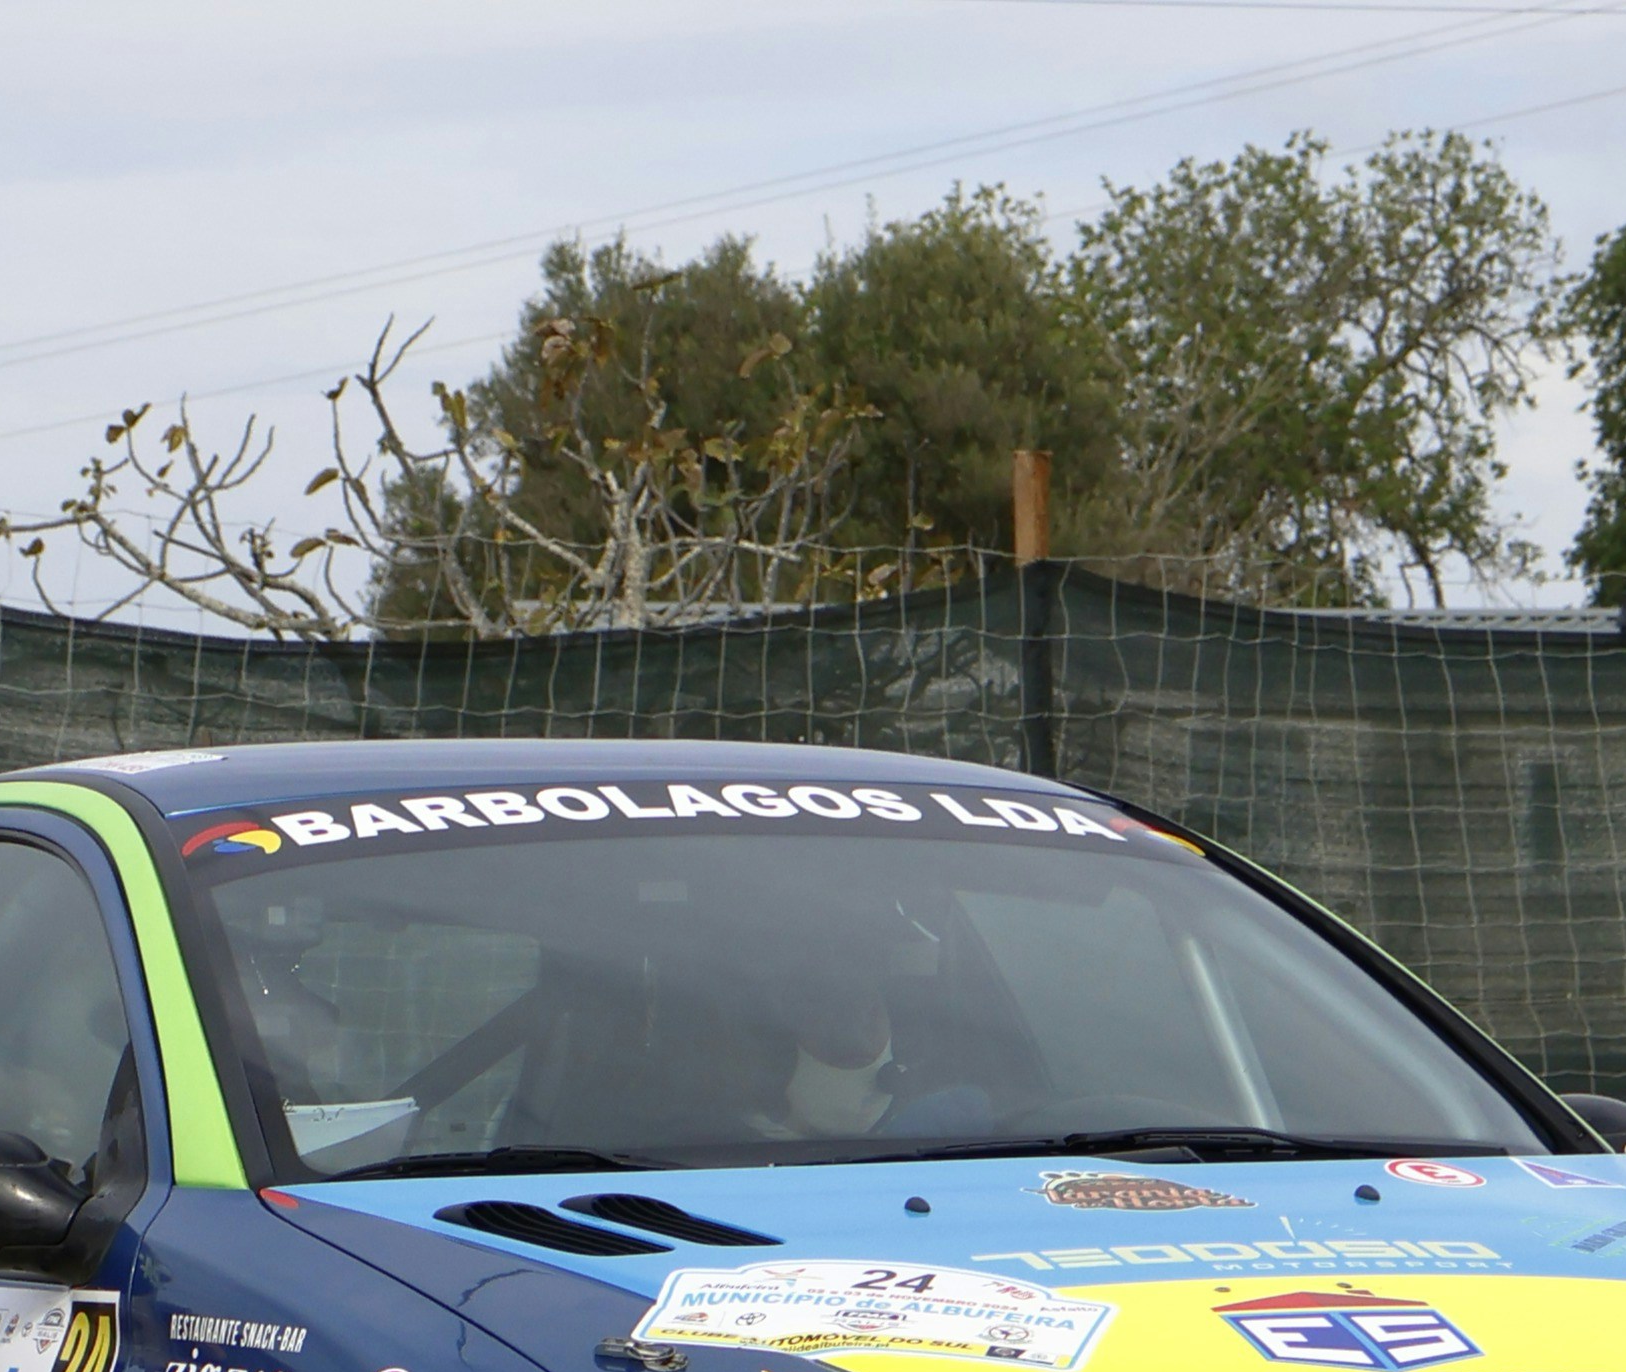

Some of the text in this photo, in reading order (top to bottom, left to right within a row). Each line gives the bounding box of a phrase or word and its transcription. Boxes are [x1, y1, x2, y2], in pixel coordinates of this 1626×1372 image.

[270, 784, 1127, 847] BARBOLAGOS LDA
[851, 1269, 937, 1293] 24
[1212, 1261, 1515, 1272] MOTORSPORT
[680, 1290, 847, 1307] MUNICÍPIO
[855, 1299, 891, 1310] de
[900, 1302, 1076, 1330] ALBUFEIRA
[170, 1314, 308, 1353] RESTAURANTE SNACK-BAR
[889, 1337, 923, 1345] DO
[929, 1340, 974, 1350] SUL
[1238, 1311, 1464, 1366] ES
